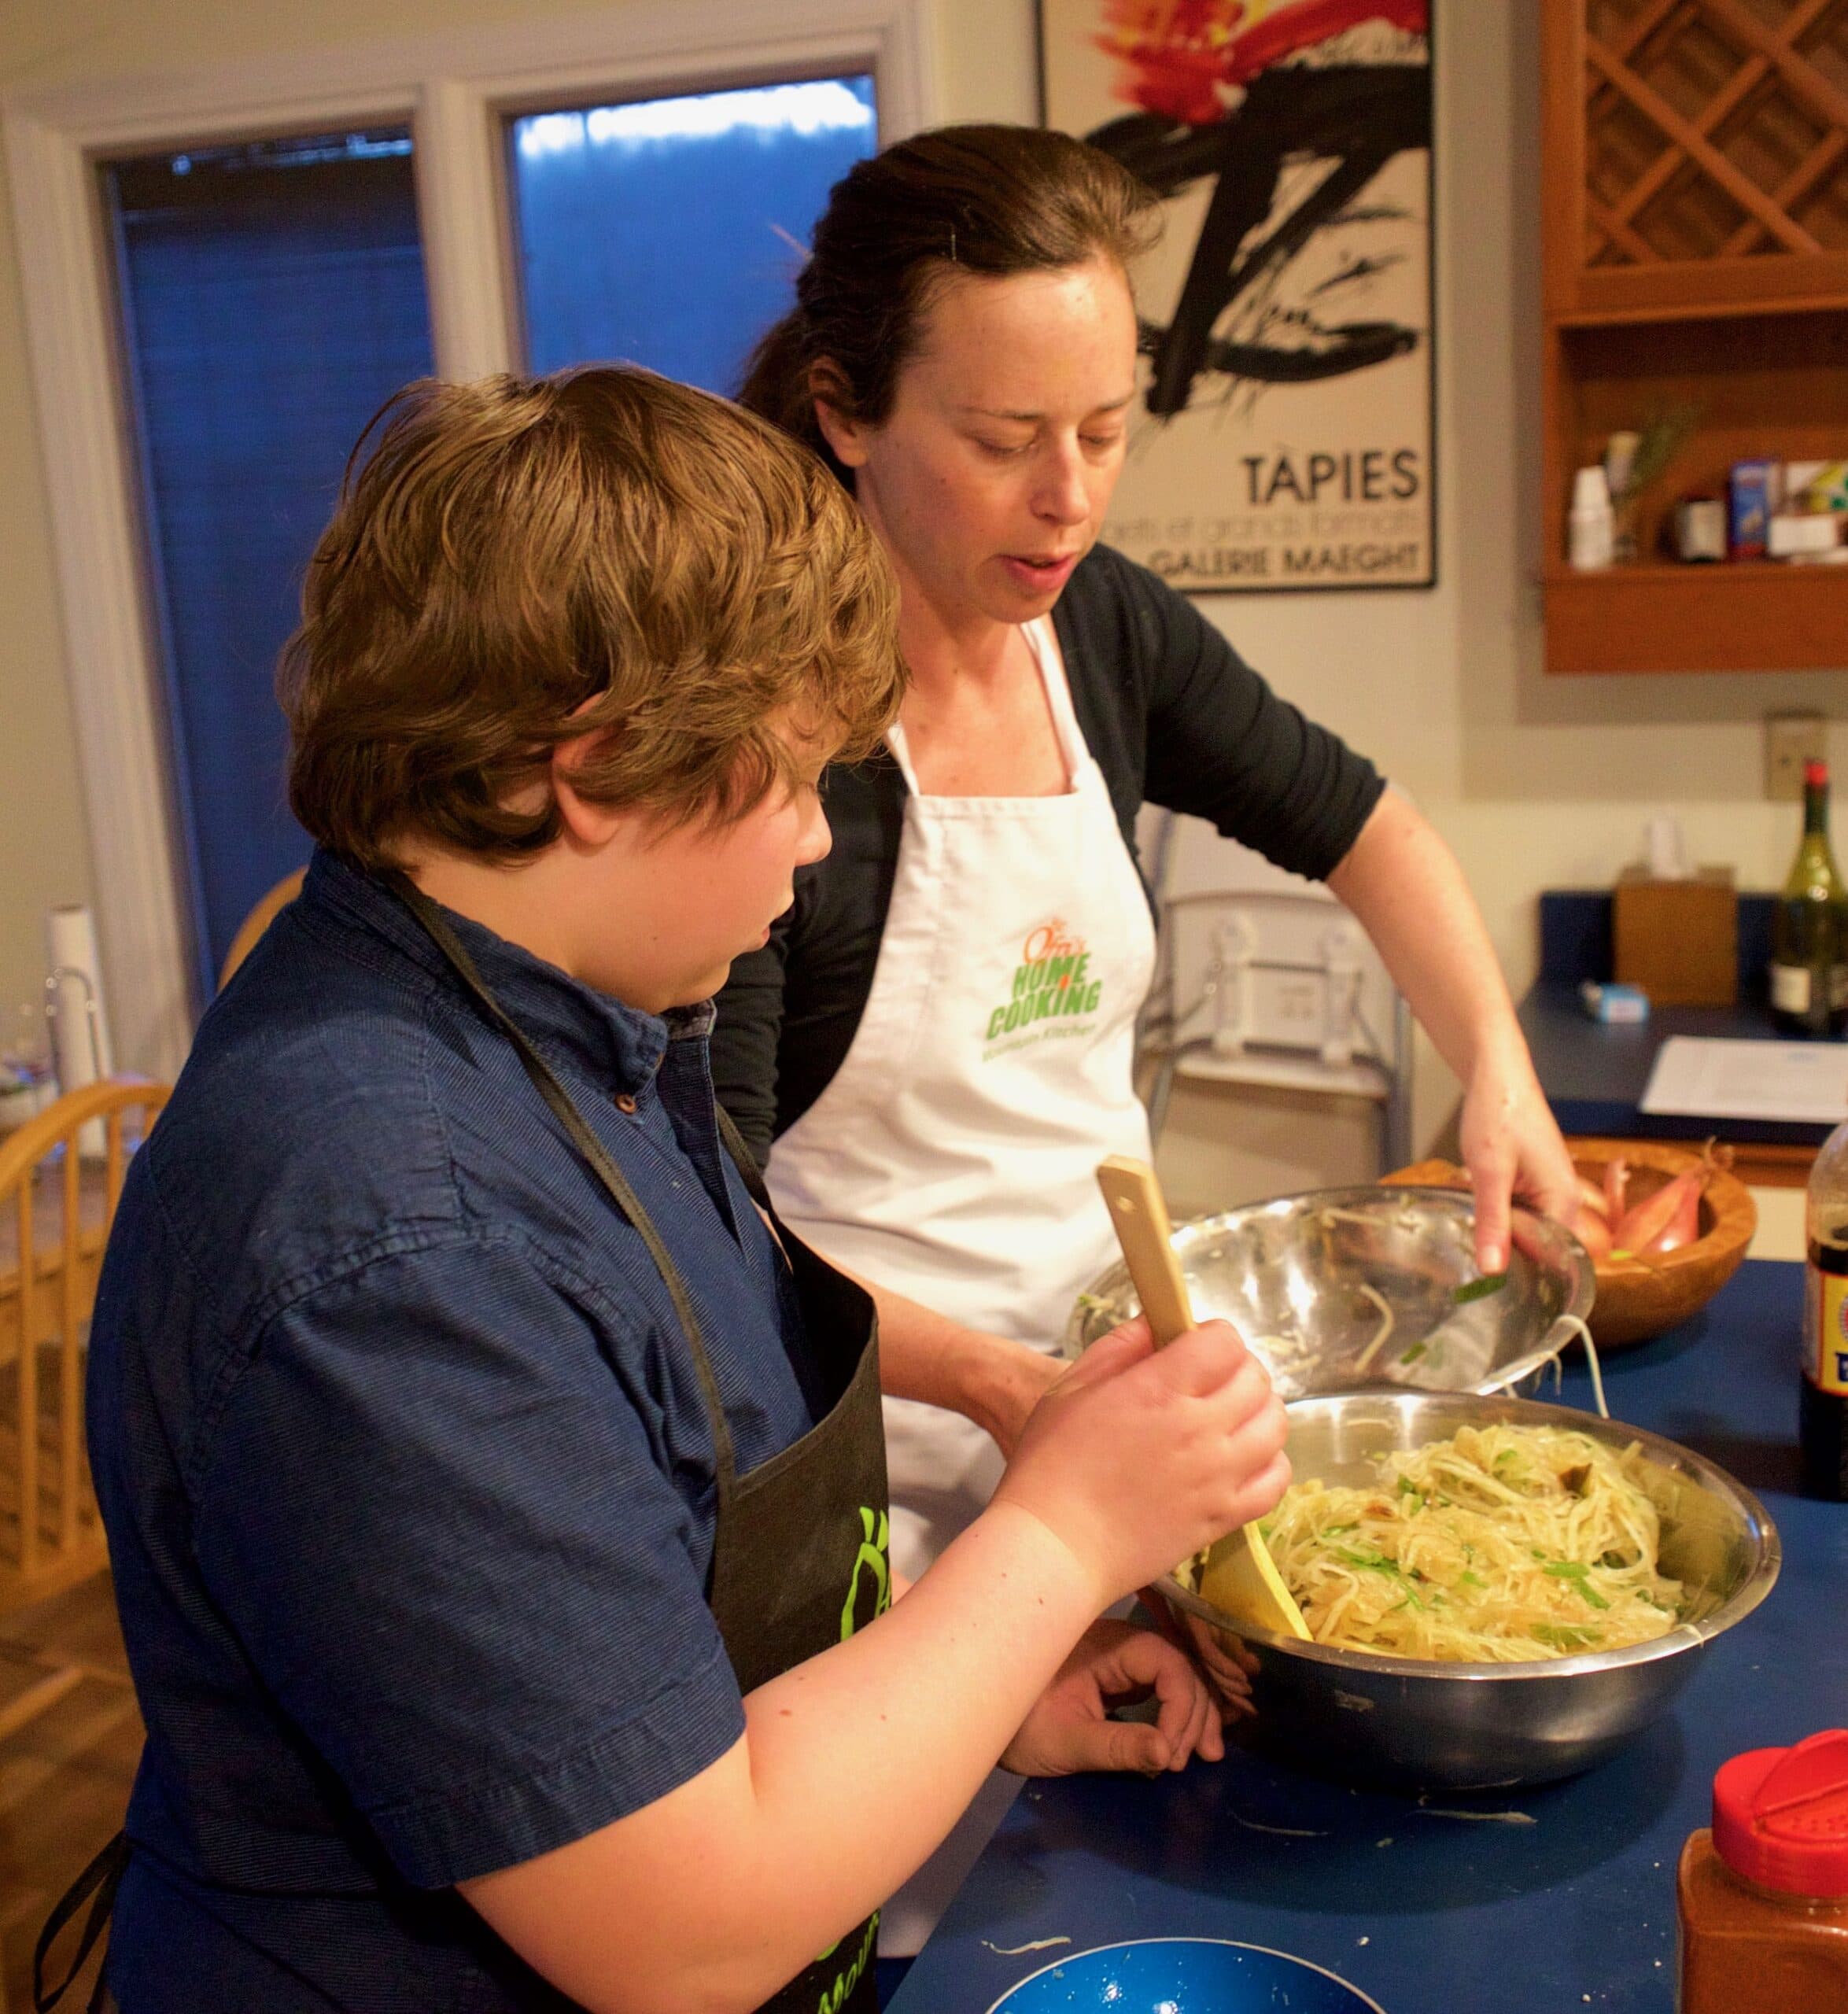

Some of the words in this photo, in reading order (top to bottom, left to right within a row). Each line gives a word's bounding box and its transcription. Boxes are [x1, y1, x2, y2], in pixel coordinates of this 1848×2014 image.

[1241, 442, 1419, 505] TÀPIES
[1148, 546, 1268, 577] GALERIE
[1283, 542, 1418, 574] MAEGHT
[1012, 952, 1091, 999] HOME
[987, 979, 1102, 1041] COOKING
